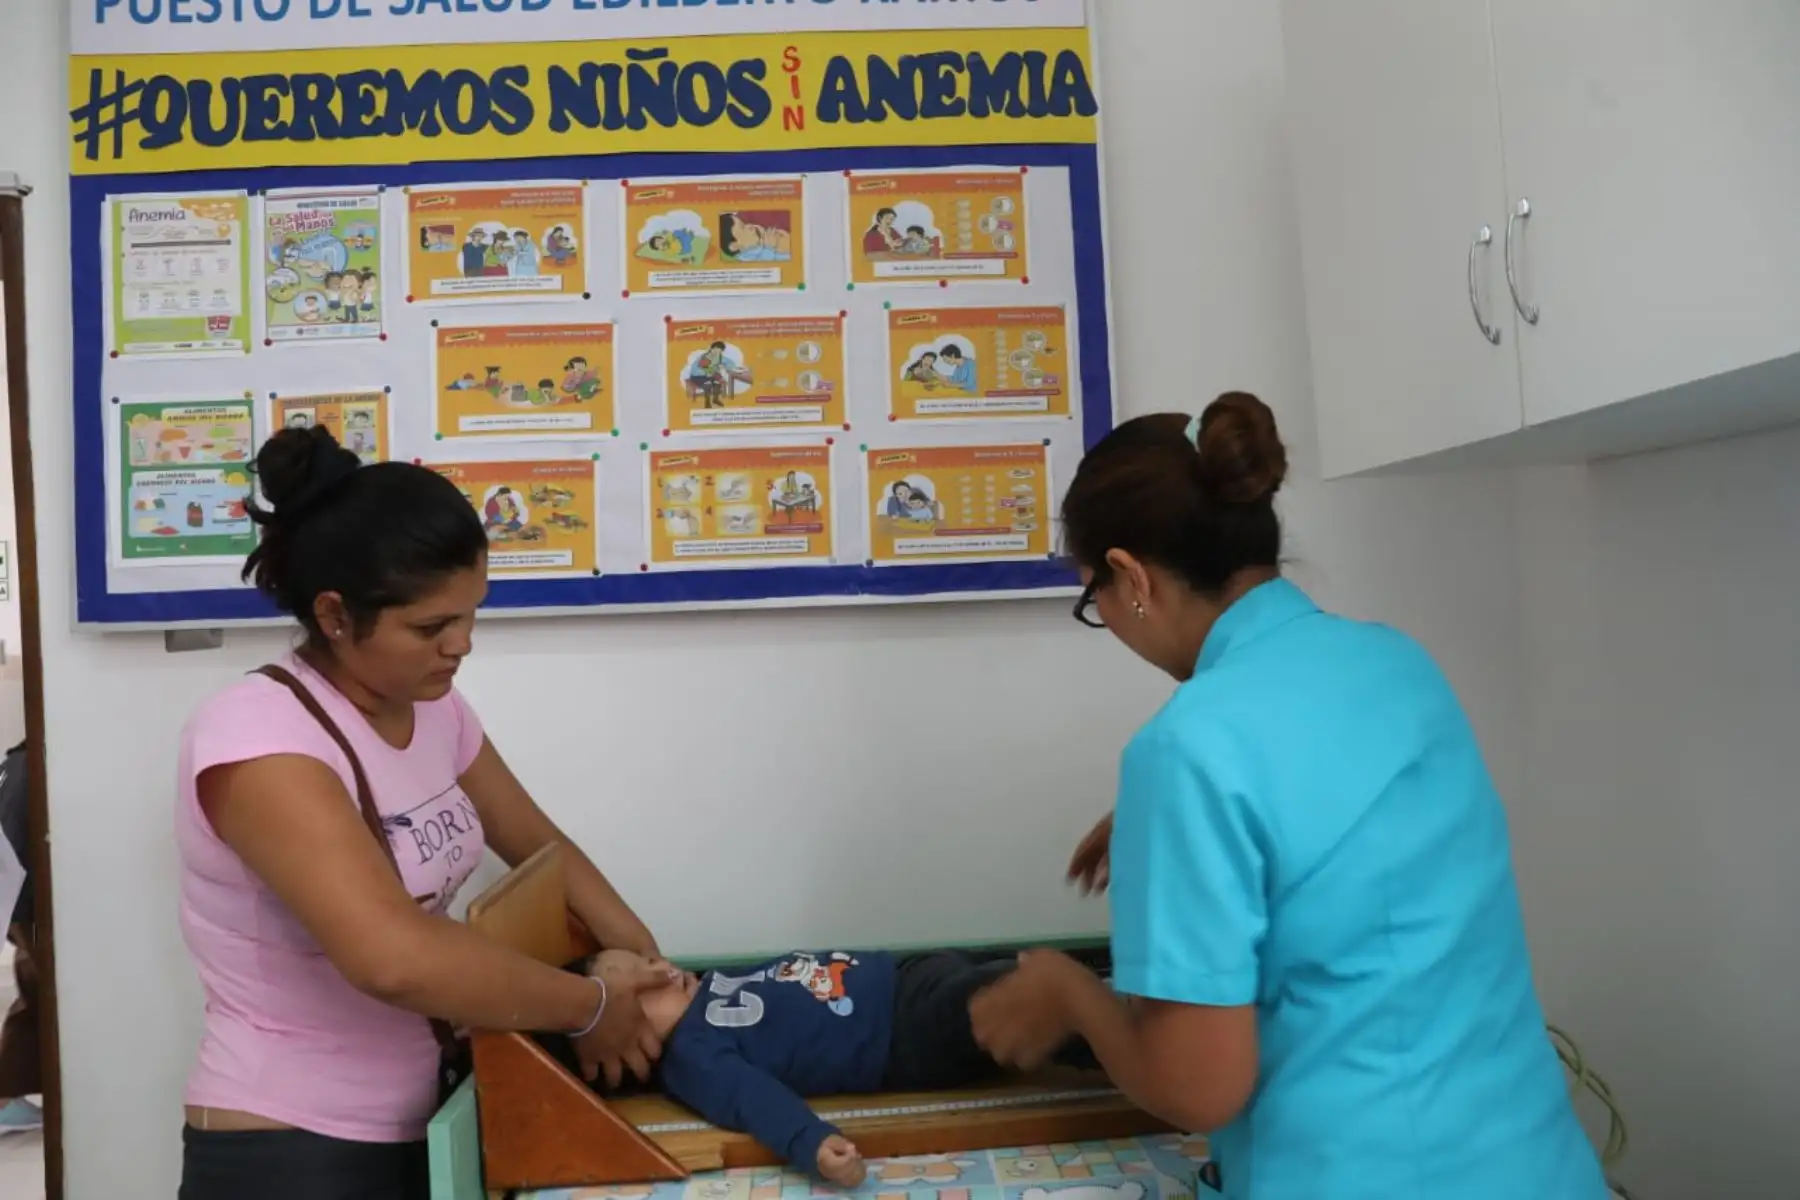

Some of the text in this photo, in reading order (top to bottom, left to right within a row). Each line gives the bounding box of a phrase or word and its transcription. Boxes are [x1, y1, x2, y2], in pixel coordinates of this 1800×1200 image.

[69, 47, 772, 161] #QUEREMOS NIÑOS
[781, 46, 805, 132] SIN
[815, 49, 1098, 124] ANEMIA
[128, 207, 187, 223] Anemia
[409, 797, 475, 866] BORN
